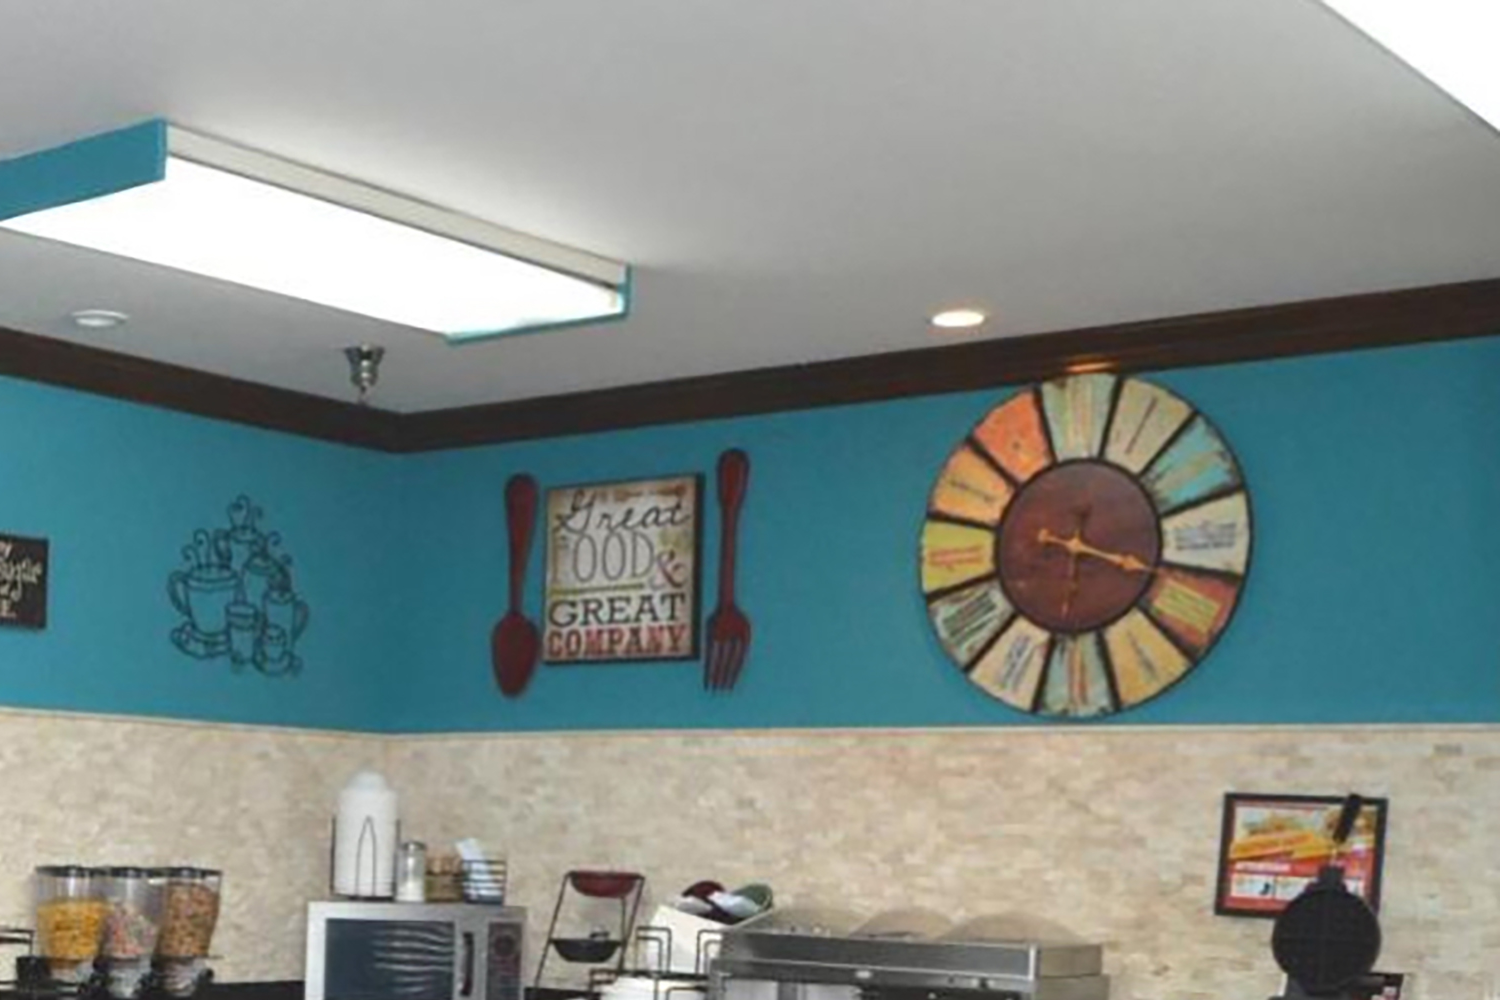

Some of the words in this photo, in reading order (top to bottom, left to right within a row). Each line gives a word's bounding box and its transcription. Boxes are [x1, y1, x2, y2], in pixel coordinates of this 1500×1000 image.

[554, 489, 691, 533] Great
[649, 550, 688, 590] &
[549, 592, 686, 628] GREAT
[548, 624, 687, 657] COMPANY
